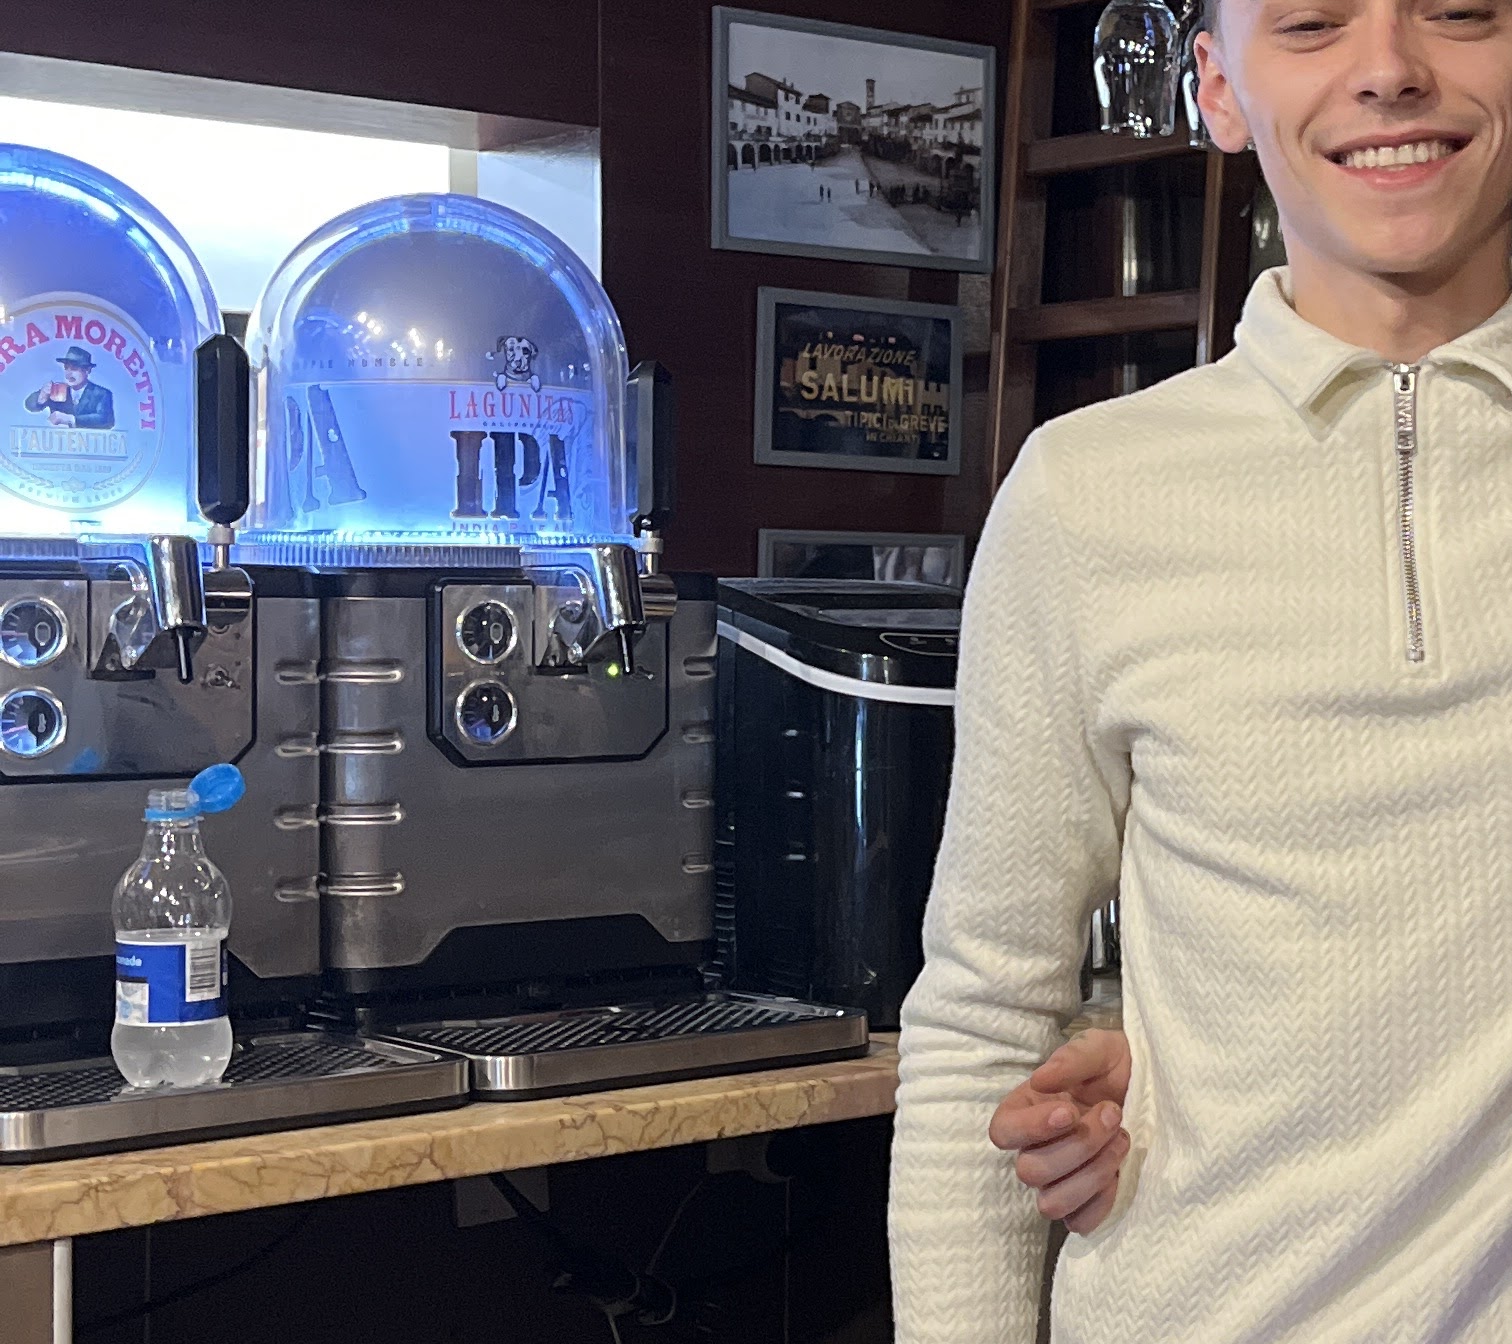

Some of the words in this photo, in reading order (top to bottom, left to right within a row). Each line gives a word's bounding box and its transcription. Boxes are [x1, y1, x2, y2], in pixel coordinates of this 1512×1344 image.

[55, 314, 156, 430] MORETTI
[803, 342, 916, 366] LAVORAZIONE
[800, 369, 914, 406] SALUMI
[449, 390, 574, 426] LAGUNITAS
[901, 414, 948, 433] GREVE
[10, 429, 129, 455] L'AUTENTICA
[450, 430, 574, 520] IPA
